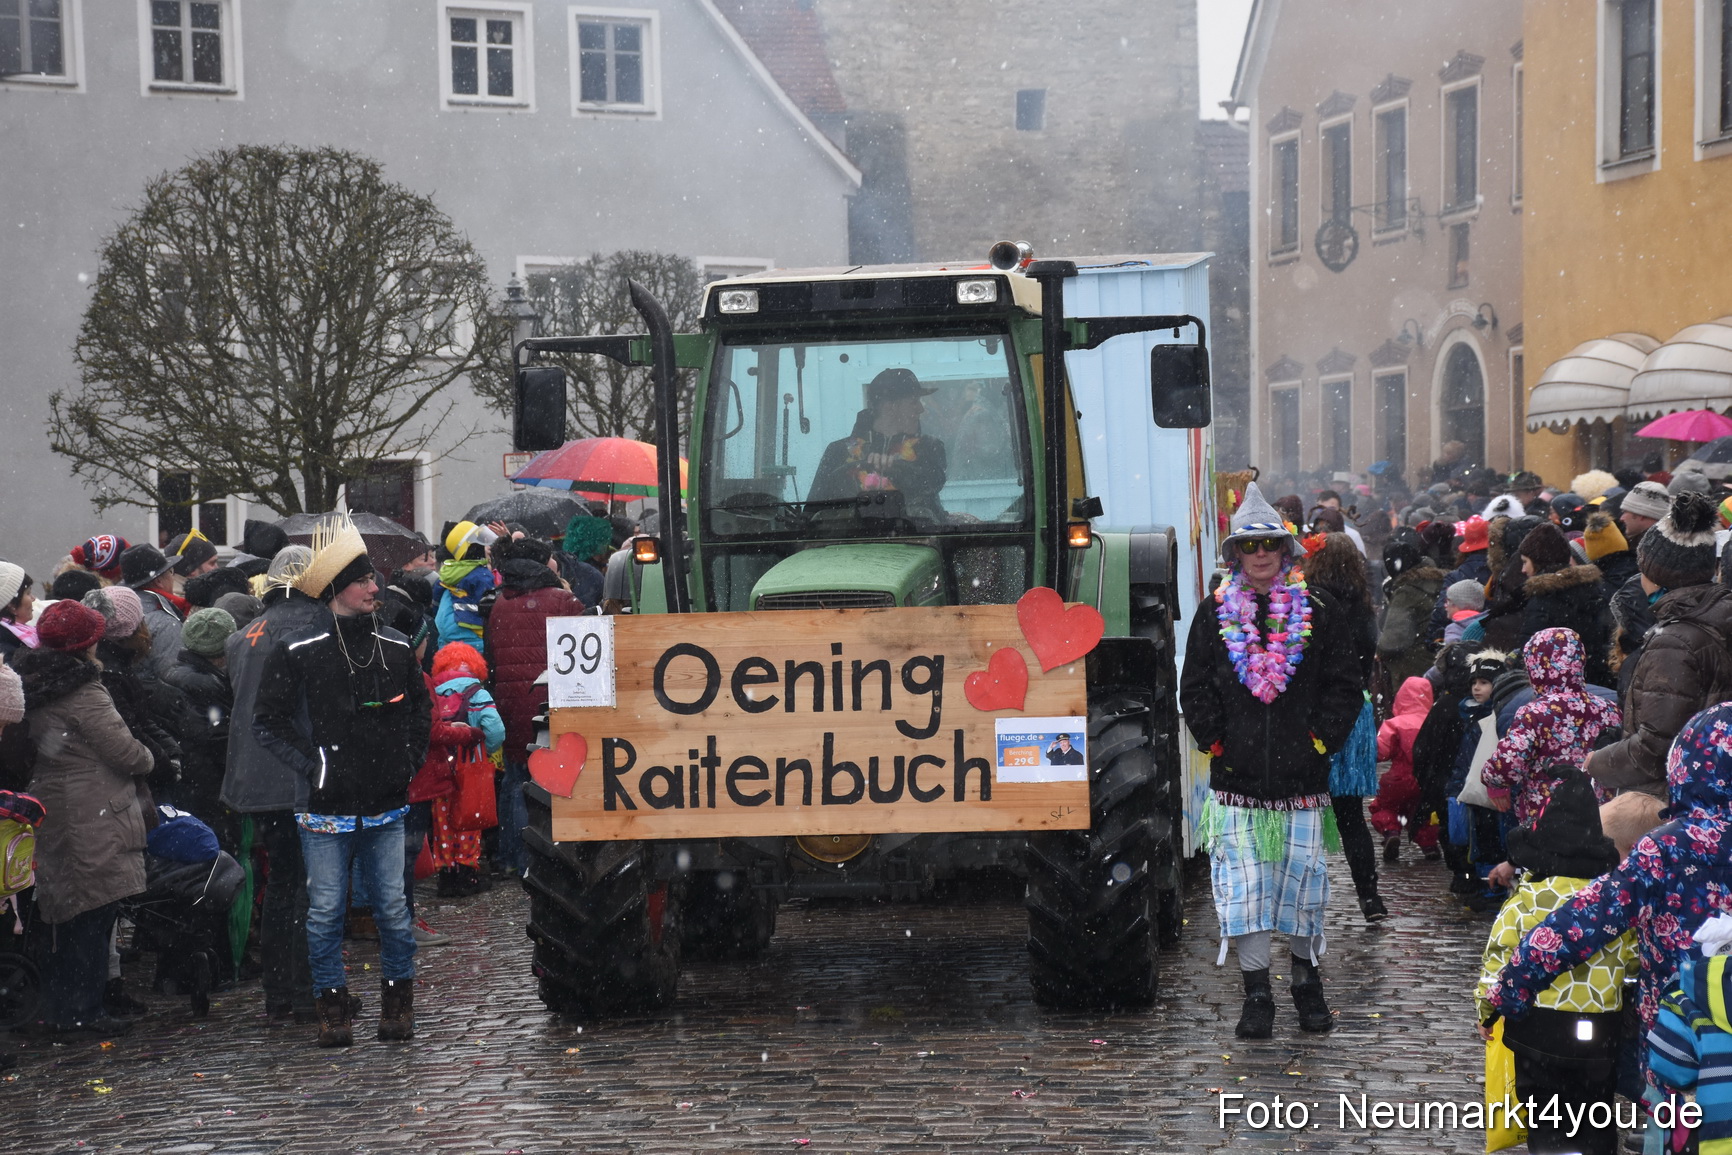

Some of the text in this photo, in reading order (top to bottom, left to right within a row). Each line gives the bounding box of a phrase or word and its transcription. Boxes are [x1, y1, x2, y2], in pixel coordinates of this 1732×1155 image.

[246, 620, 267, 648] 4
[554, 633, 602, 675] 39
[653, 642, 944, 739] Oening
[1000, 733, 1037, 742] fluege.de
[601, 729, 992, 811] Raitenbuch
